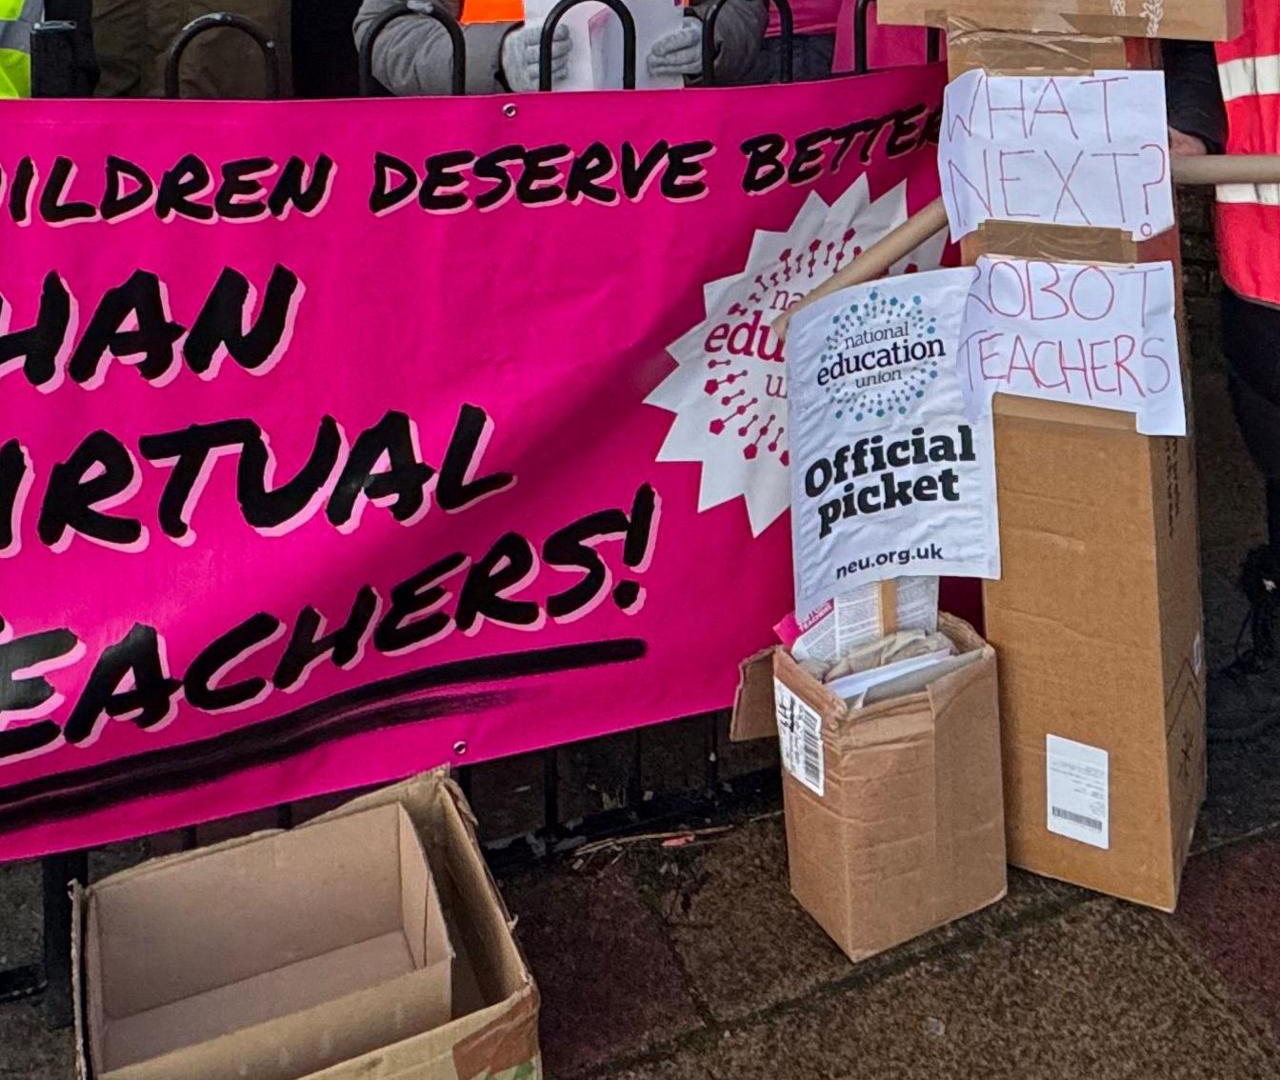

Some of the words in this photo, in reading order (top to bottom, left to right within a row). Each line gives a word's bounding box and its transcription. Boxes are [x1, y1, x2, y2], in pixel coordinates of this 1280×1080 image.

[945, 76, 1129, 143] WHAT
[369, 140, 719, 216] DESERVE
[948, 143, 1166, 239] NEXT?
[817, 338, 947, 386] education
[844, 321, 910, 350] national
[957, 330, 1171, 400] TEACHERS
[855, 369, 902, 389] union
[805, 424, 976, 498] Official
[818, 468, 960, 539] picket
[835, 542, 944, 579] neu.org.uk
